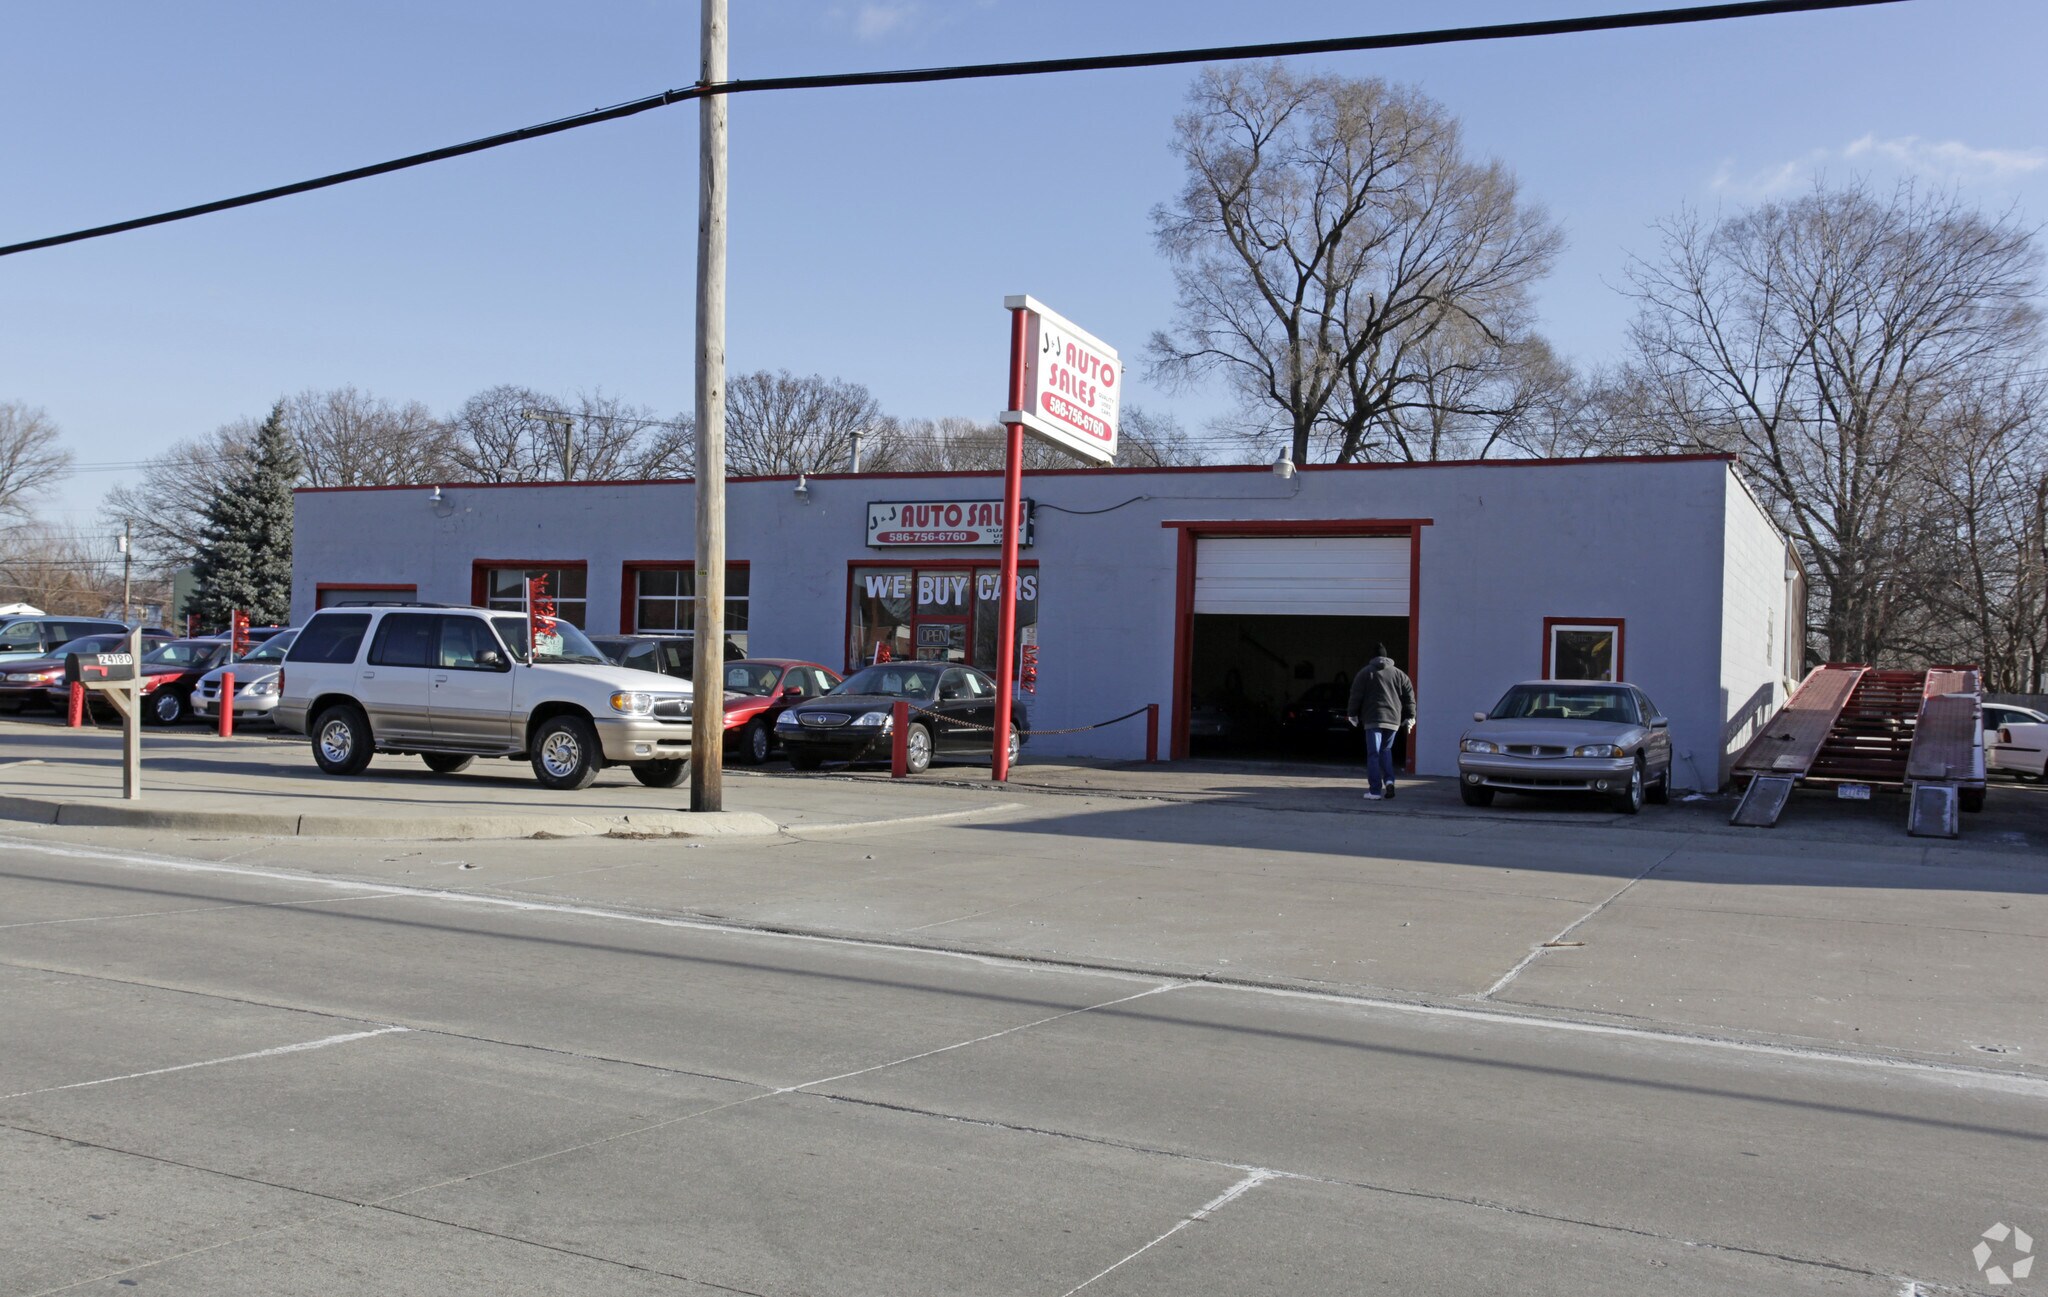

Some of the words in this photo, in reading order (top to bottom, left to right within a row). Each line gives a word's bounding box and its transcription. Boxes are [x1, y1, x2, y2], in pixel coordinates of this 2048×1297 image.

[1043, 332, 1050, 354] J
[1056, 336, 1061, 357] J
[1066, 342, 1115, 388] AUTO
[1049, 363, 1096, 408] SALES
[1049, 396, 1105, 437] 586-756-6760
[870, 516, 878, 530] J
[888, 506, 897, 521] J
[901, 504, 963, 528] AUTO
[967, 502, 1026, 527] SALS
[889, 532, 967, 542] 586-756-6760
[865, 575, 906, 599] WE
[918, 576, 968, 606] BUY
[921, 629, 947, 643] OPEN
[99, 654, 131, 664] 24180
